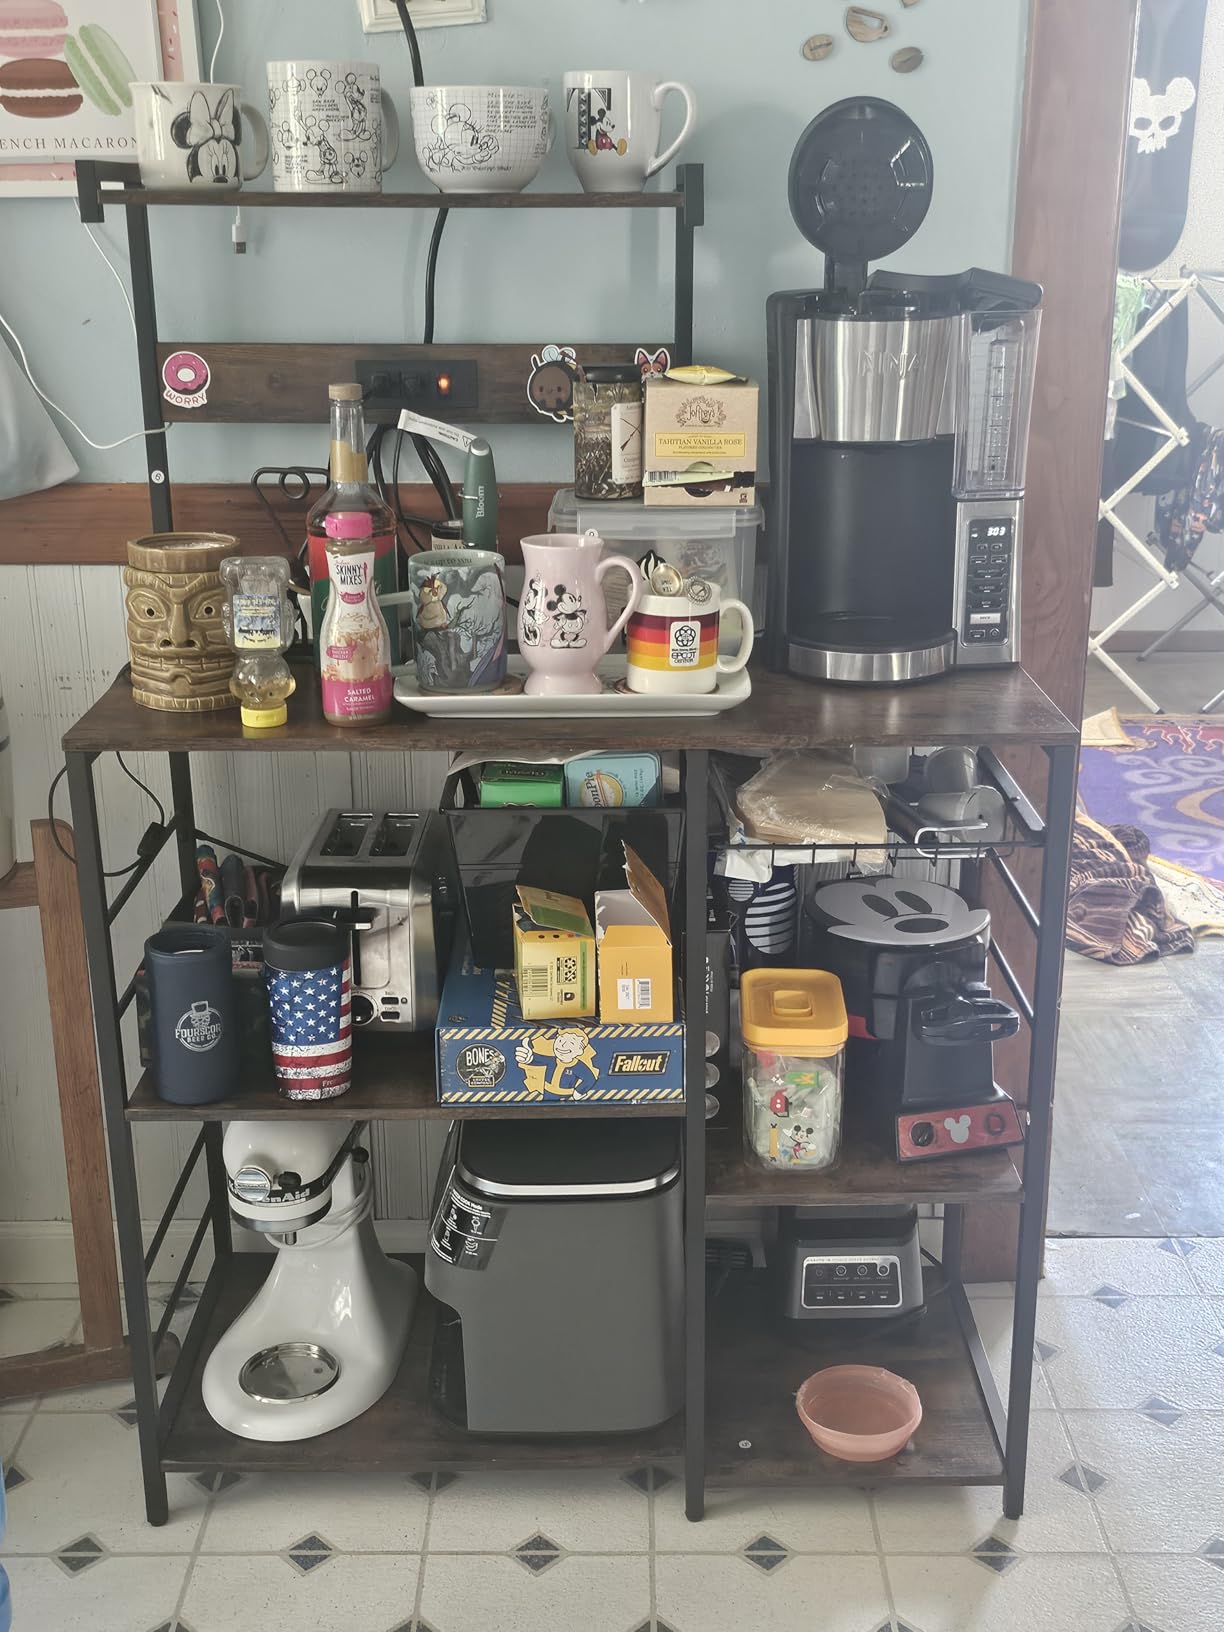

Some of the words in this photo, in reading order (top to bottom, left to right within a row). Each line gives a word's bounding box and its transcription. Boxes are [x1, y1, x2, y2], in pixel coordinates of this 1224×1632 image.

[165, 391, 206, 405] WORRY
[658, 438, 693, 446] TAHITIAN
[693, 438, 723, 446] VANILLA
[724, 438, 743, 446] ROSE
[475, 485, 485, 519] Bloom
[336, 565, 362, 576] SKINNY
[340, 575, 363, 586] MIXES
[347, 687, 372, 696] SALTED
[344, 694, 375, 703] CARAMEL
[465, 1047, 495, 1066] BONES
[615, 1054, 663, 1073] Fallout
